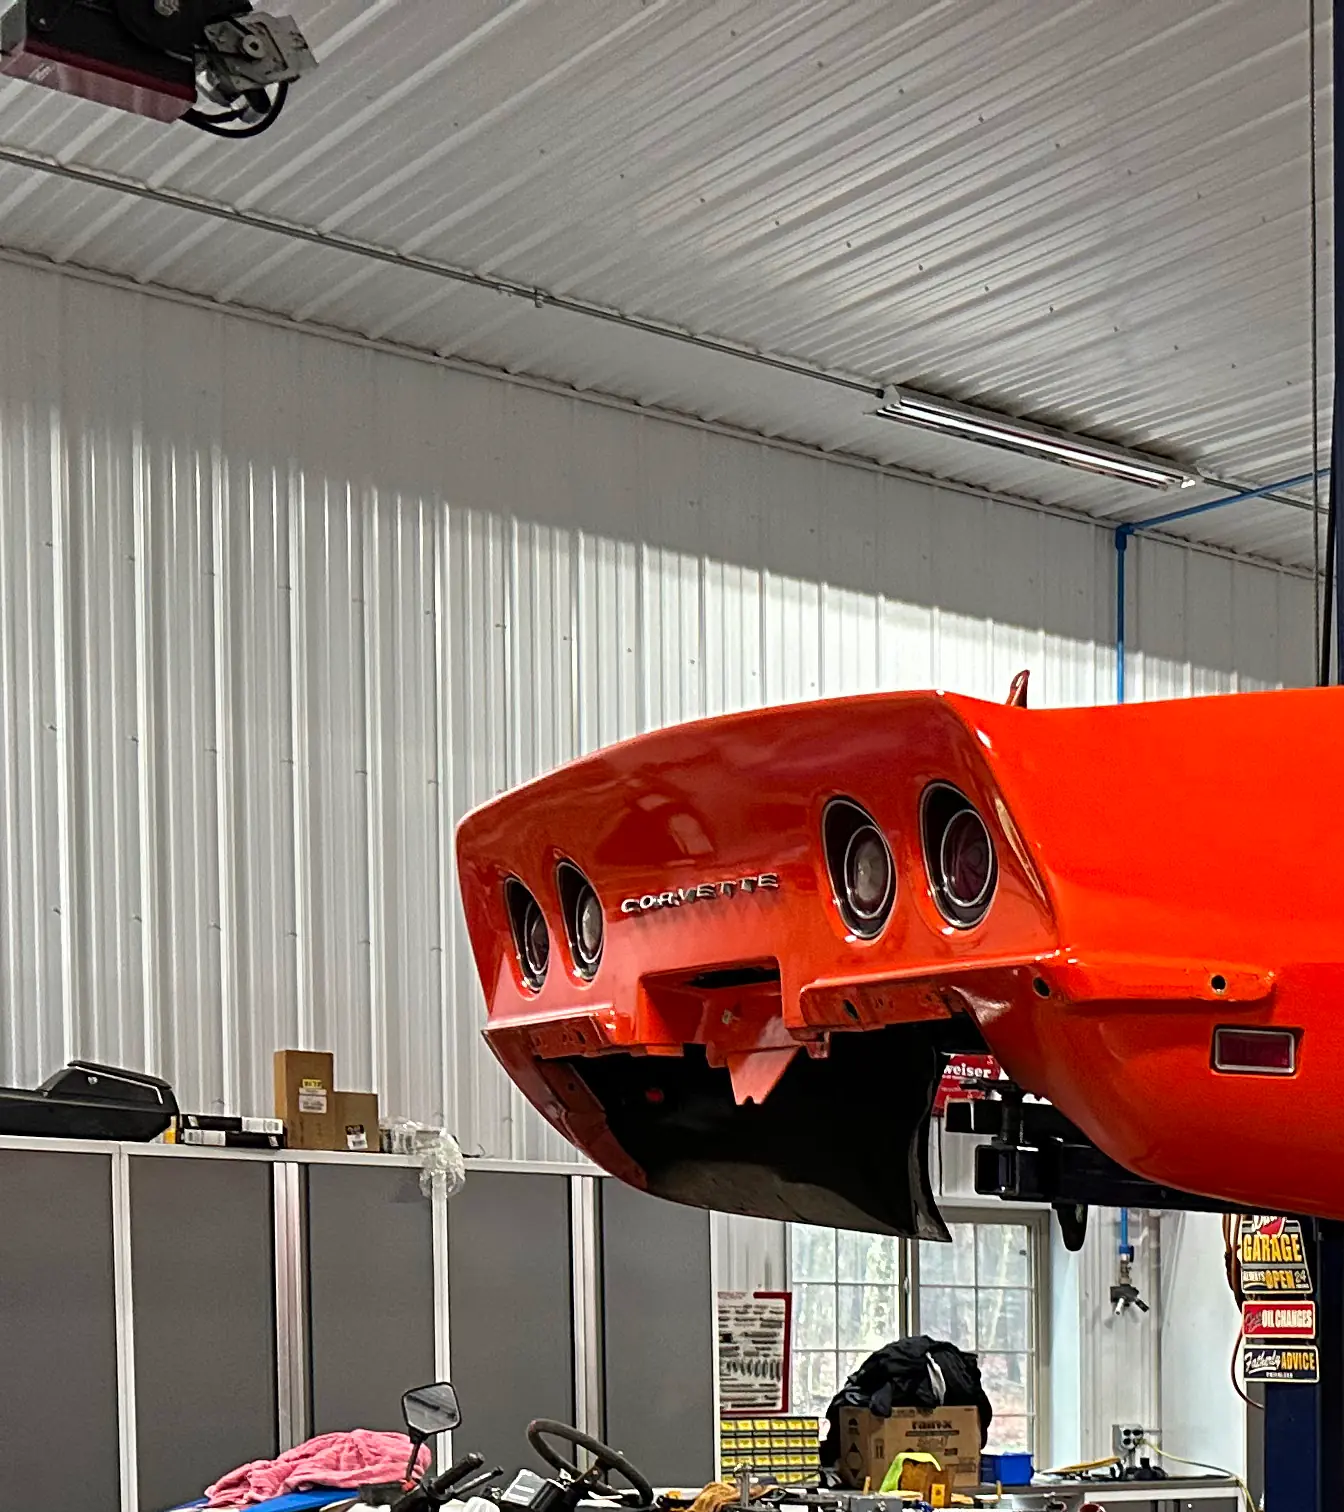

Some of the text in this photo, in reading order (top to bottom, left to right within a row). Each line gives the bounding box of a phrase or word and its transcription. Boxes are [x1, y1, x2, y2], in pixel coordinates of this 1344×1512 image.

[621, 872, 778, 913] CORVETTE
[1242, 1233, 1302, 1262] GARAGE
[1264, 1269, 1296, 1289] OPEN
[1294, 1270, 1307, 1284] 24
[1261, 1309, 1275, 1328] OIL
[1275, 1309, 1313, 1328] CHANGES
[1244, 1349, 1316, 1373] Fatherly ADVICE
